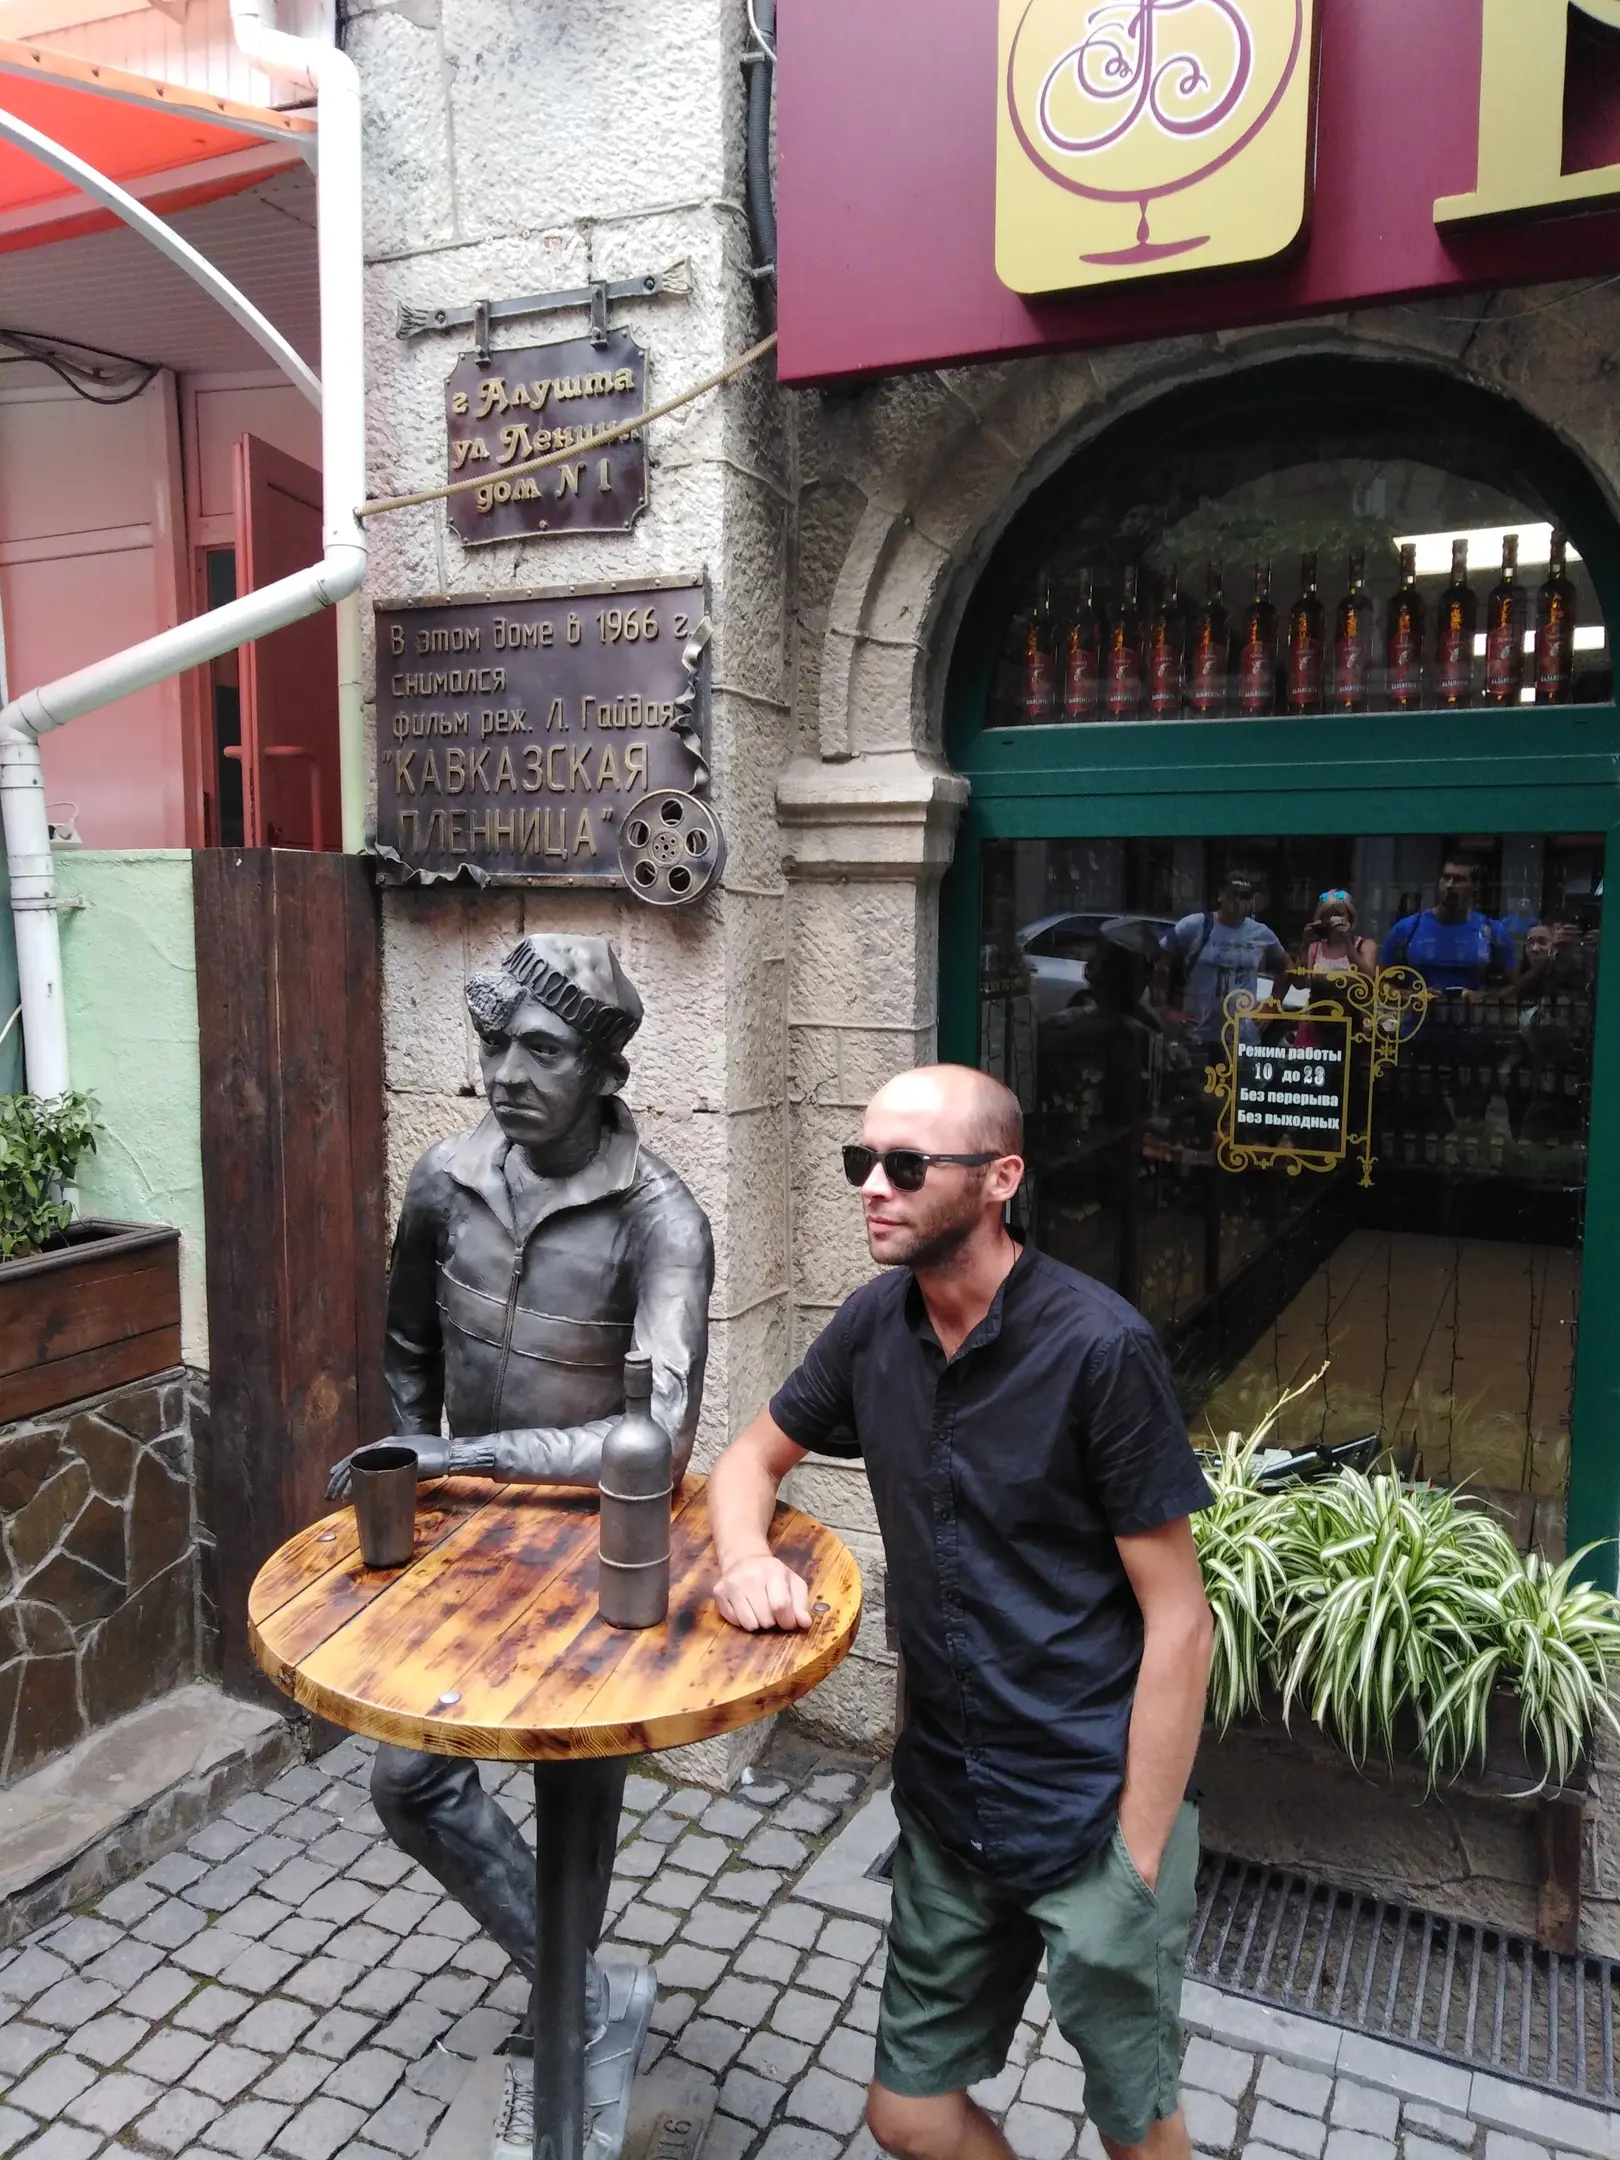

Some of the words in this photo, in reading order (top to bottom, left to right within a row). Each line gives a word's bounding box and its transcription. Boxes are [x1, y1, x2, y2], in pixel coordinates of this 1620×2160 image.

[475, 367, 636, 418] Алушта
[451, 437, 490, 470] ул
[476, 477, 542, 513] дом
[599, 457, 612, 492] 1
[390, 625, 404, 655] В
[415, 625, 480, 654] этом
[492, 616, 553, 650] доме
[566, 612, 581, 646] в
[597, 606, 659, 645] 1966
[391, 667, 507, 697] снимался
[392, 711, 469, 743] фильм
[480, 708, 533, 743] реж.
[547, 698, 570, 732] Л.
[581, 694, 677, 731] Гайдая
[1238, 1043, 1286, 1059] Режим
[1288, 1047, 1342, 1062] работы
[1254, 1062, 1273, 1080] 10
[1281, 1070, 1301, 1083] до
[1303, 1065, 1326, 1087] 23
[1240, 1087, 1265, 1102] Без
[1267, 1090, 1339, 1107] перерыва
[1237, 1109, 1262, 1124] Без
[1264, 1113, 1340, 1130] выходных
